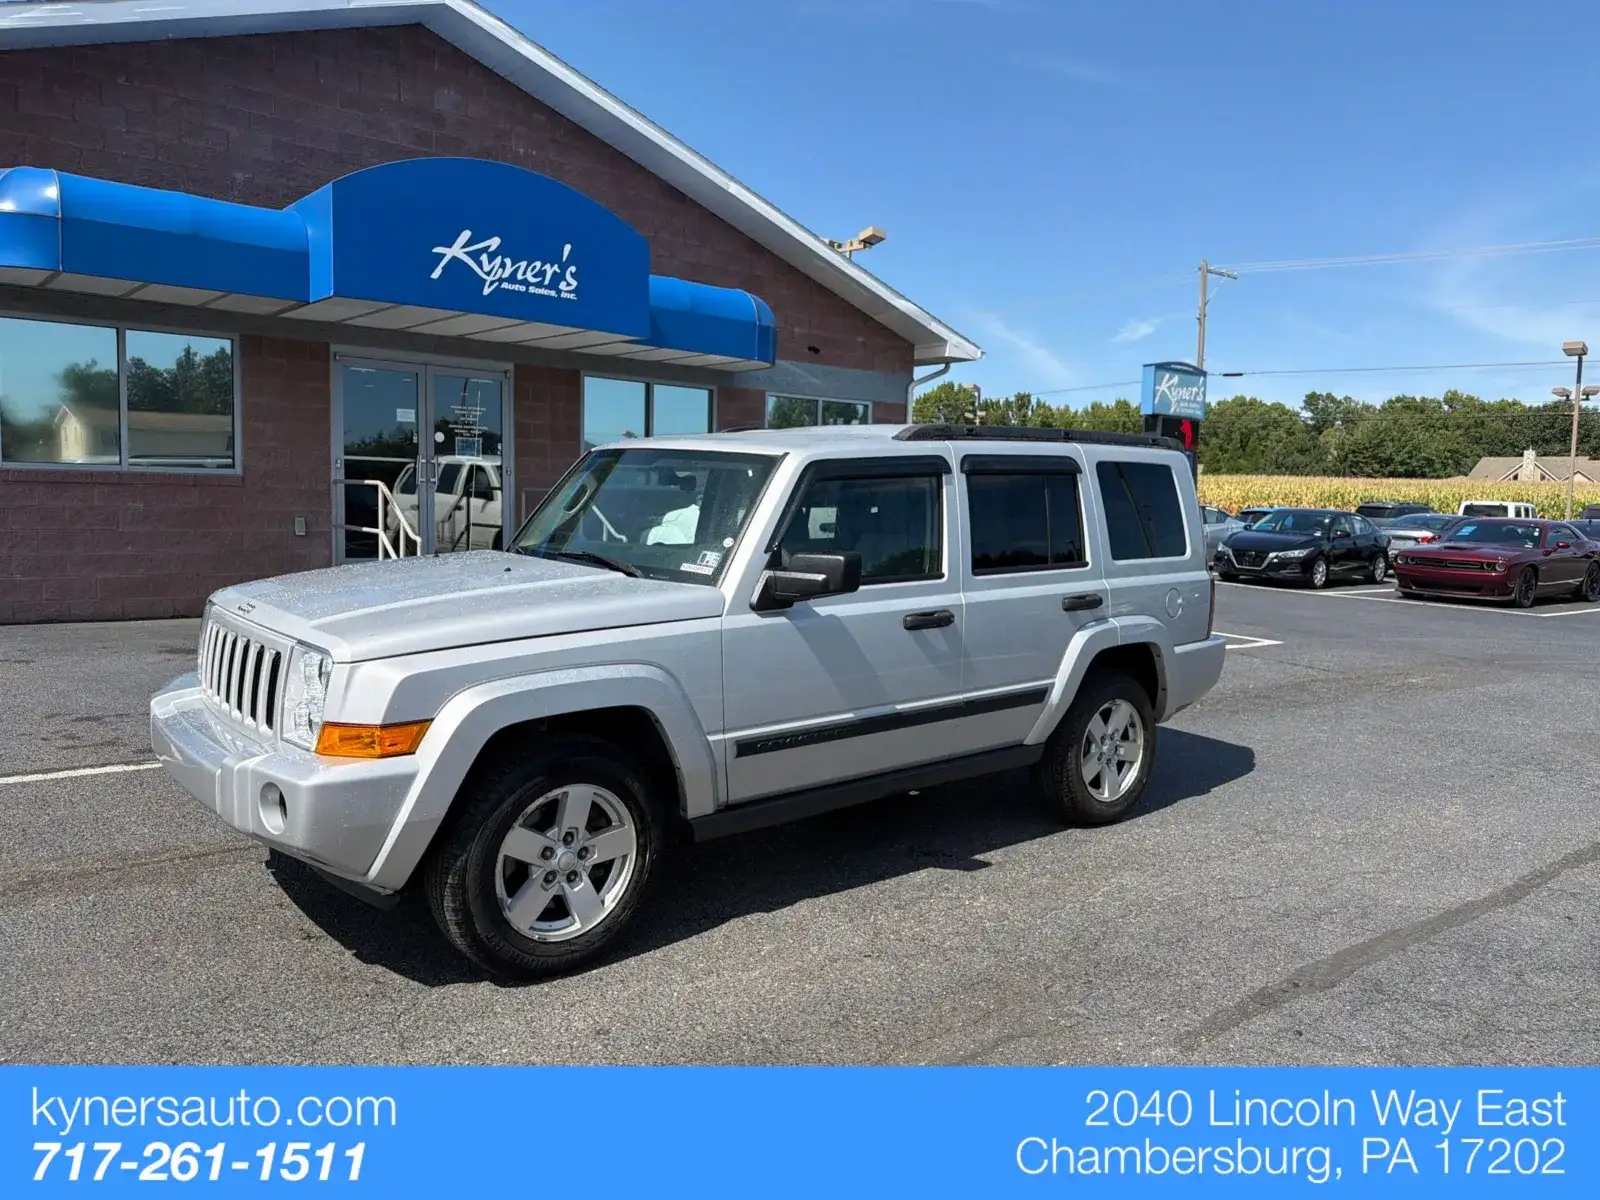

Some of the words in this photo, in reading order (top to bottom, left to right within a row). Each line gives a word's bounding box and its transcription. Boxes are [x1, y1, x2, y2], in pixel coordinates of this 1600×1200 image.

[430, 229, 578, 296] Kyner's
[500, 281, 526, 292] Auto
[1154, 373, 1205, 414] Kyner's
